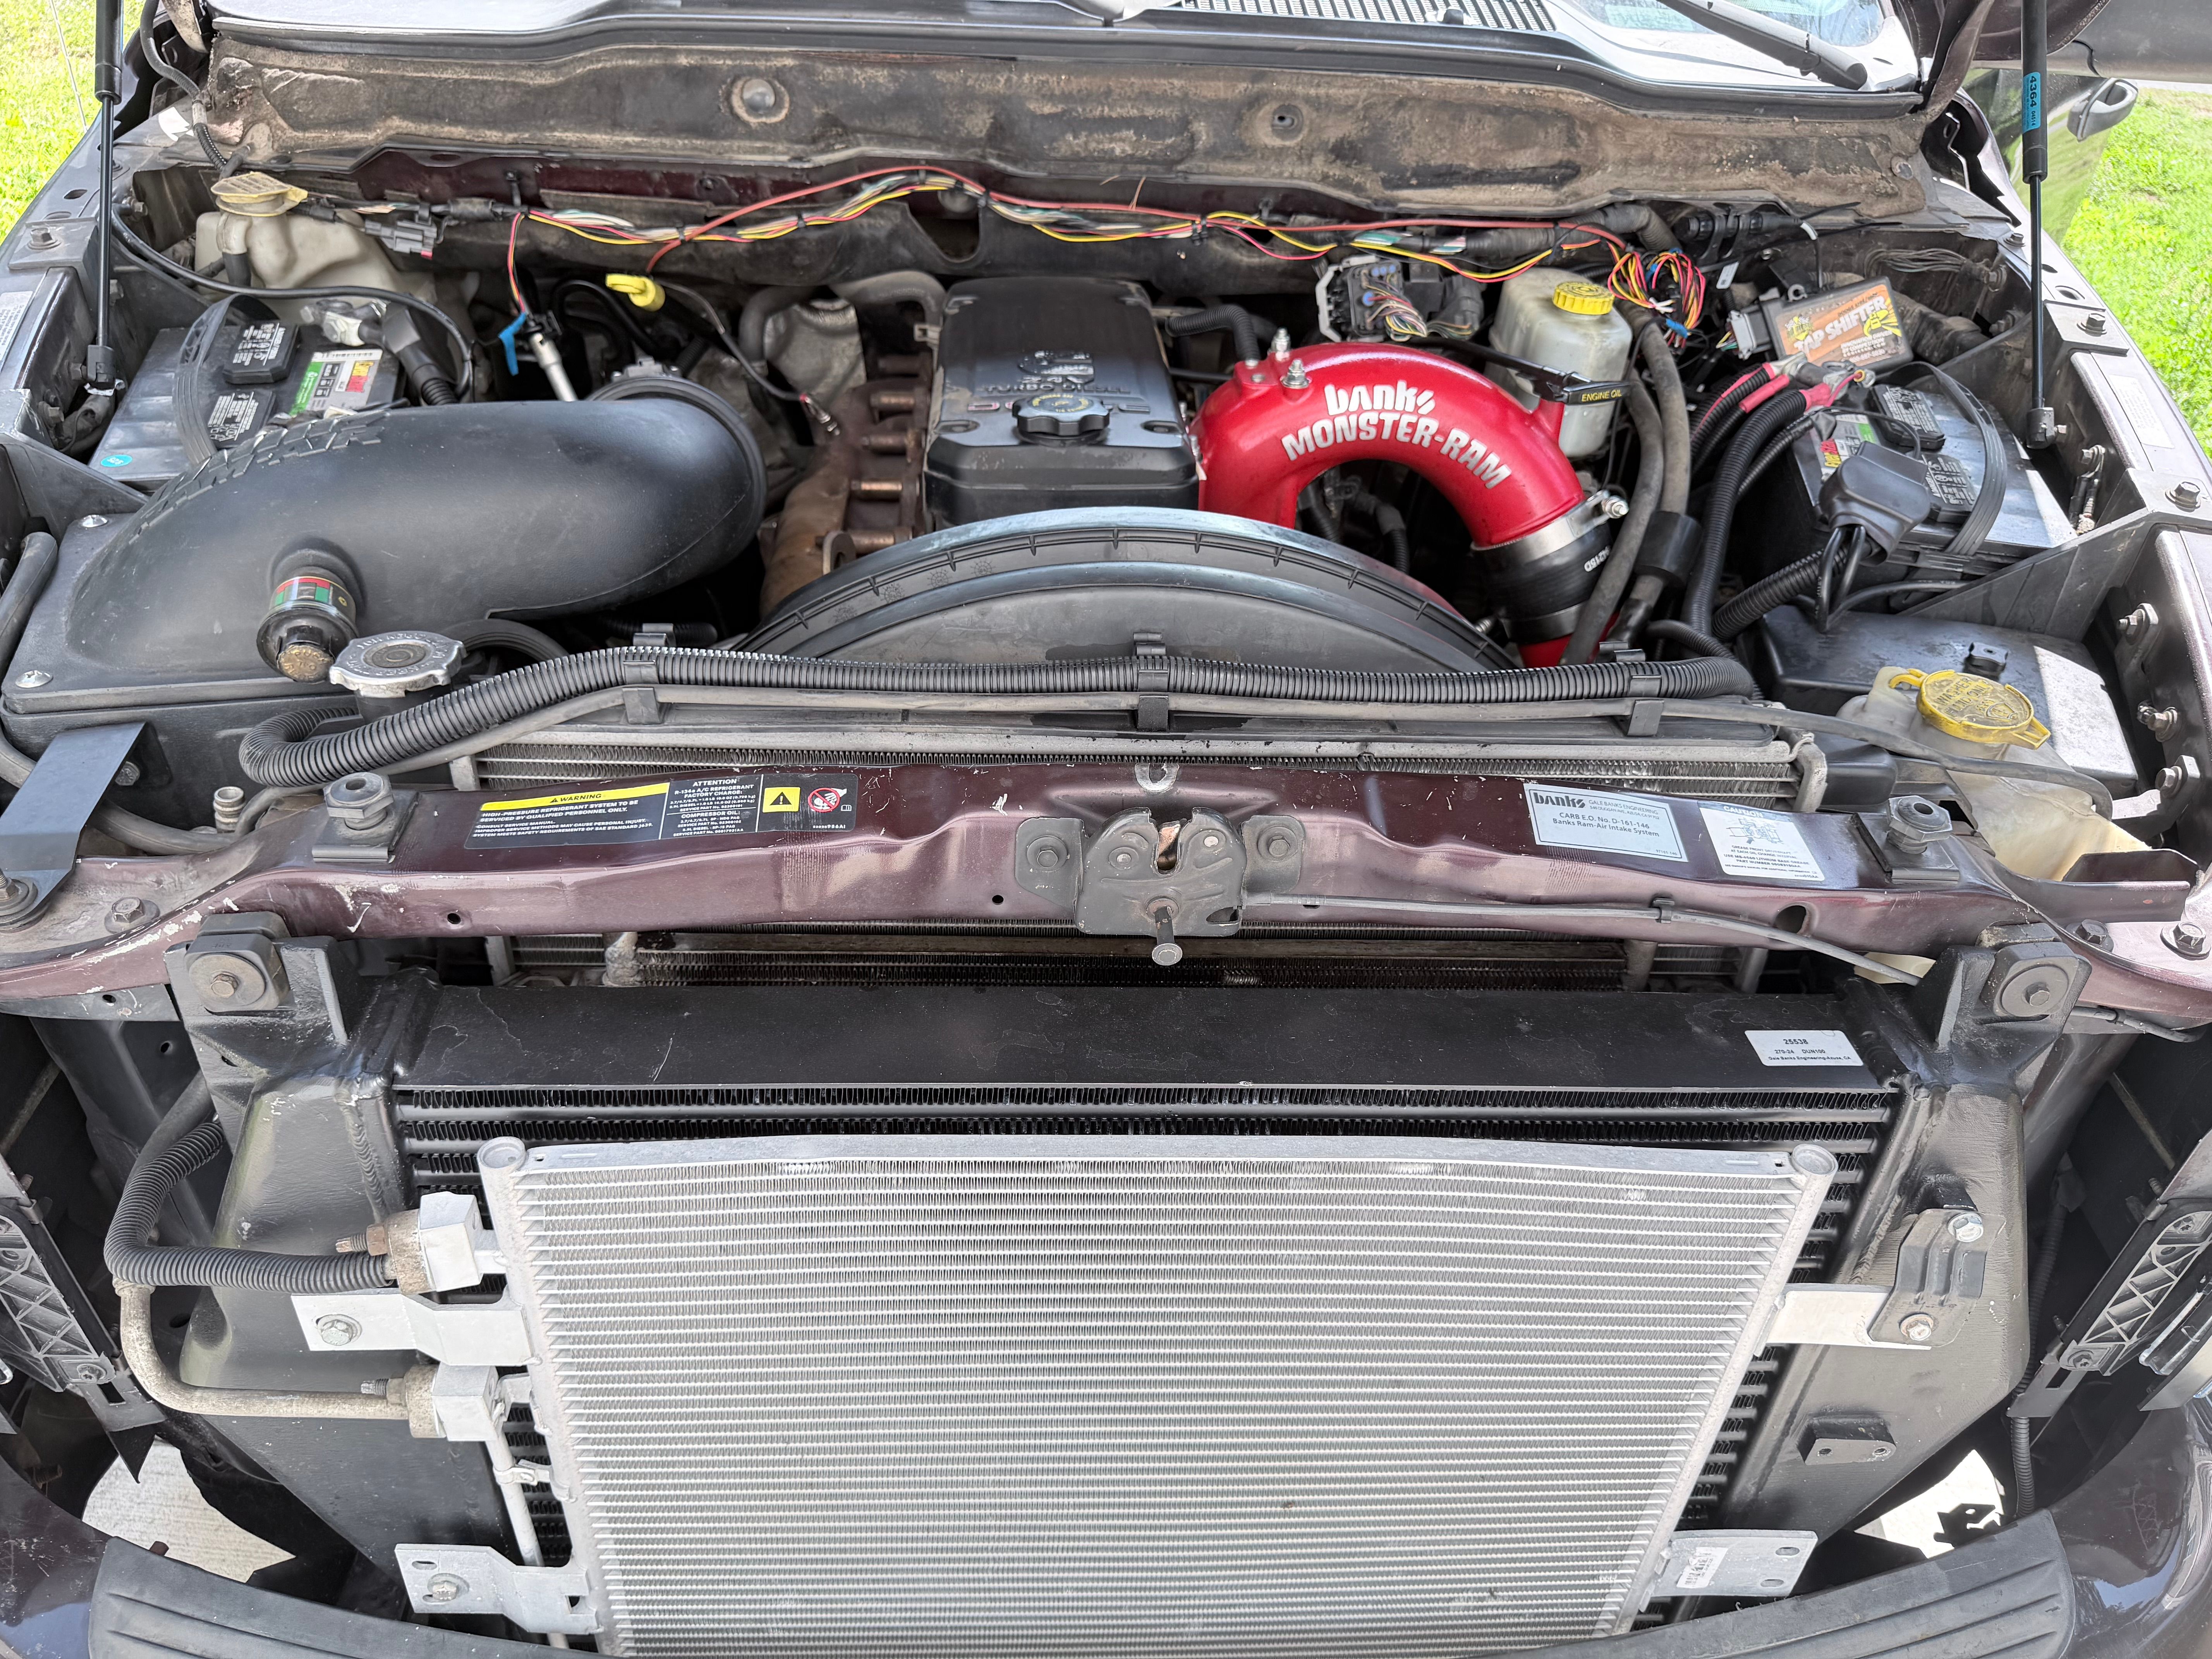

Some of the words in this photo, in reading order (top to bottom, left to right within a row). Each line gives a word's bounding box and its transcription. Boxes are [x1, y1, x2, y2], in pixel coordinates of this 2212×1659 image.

[1794, 329, 1825, 354] TAP
[1825, 295, 1887, 341] SHIFTER
[1324, 380, 1436, 416] banks
[1581, 391, 1609, 402] ENGINE
[1611, 389, 1622, 398] OIL
[1281, 412, 1511, 489] MONSTER-RAM
[1934, 677, 1972, 706] WASHER
[692, 779, 737, 787] ATTENTION
[560, 793, 602, 802] WARNING
[1533, 792, 1585, 808] banks
[1623, 804, 1659, 815] ENGINEERING
[482, 809, 539, 817] HIGH-PRESSURE
[540, 804, 589, 813] REFRIGERANT
[1723, 805, 1764, 817] CAUTION
[1577, 821, 1607, 829] Ram-Air
[1608, 824, 1632, 833] Intake
[1633, 827, 1659, 837] System
[1612, 818, 1650, 829] D-161-146
